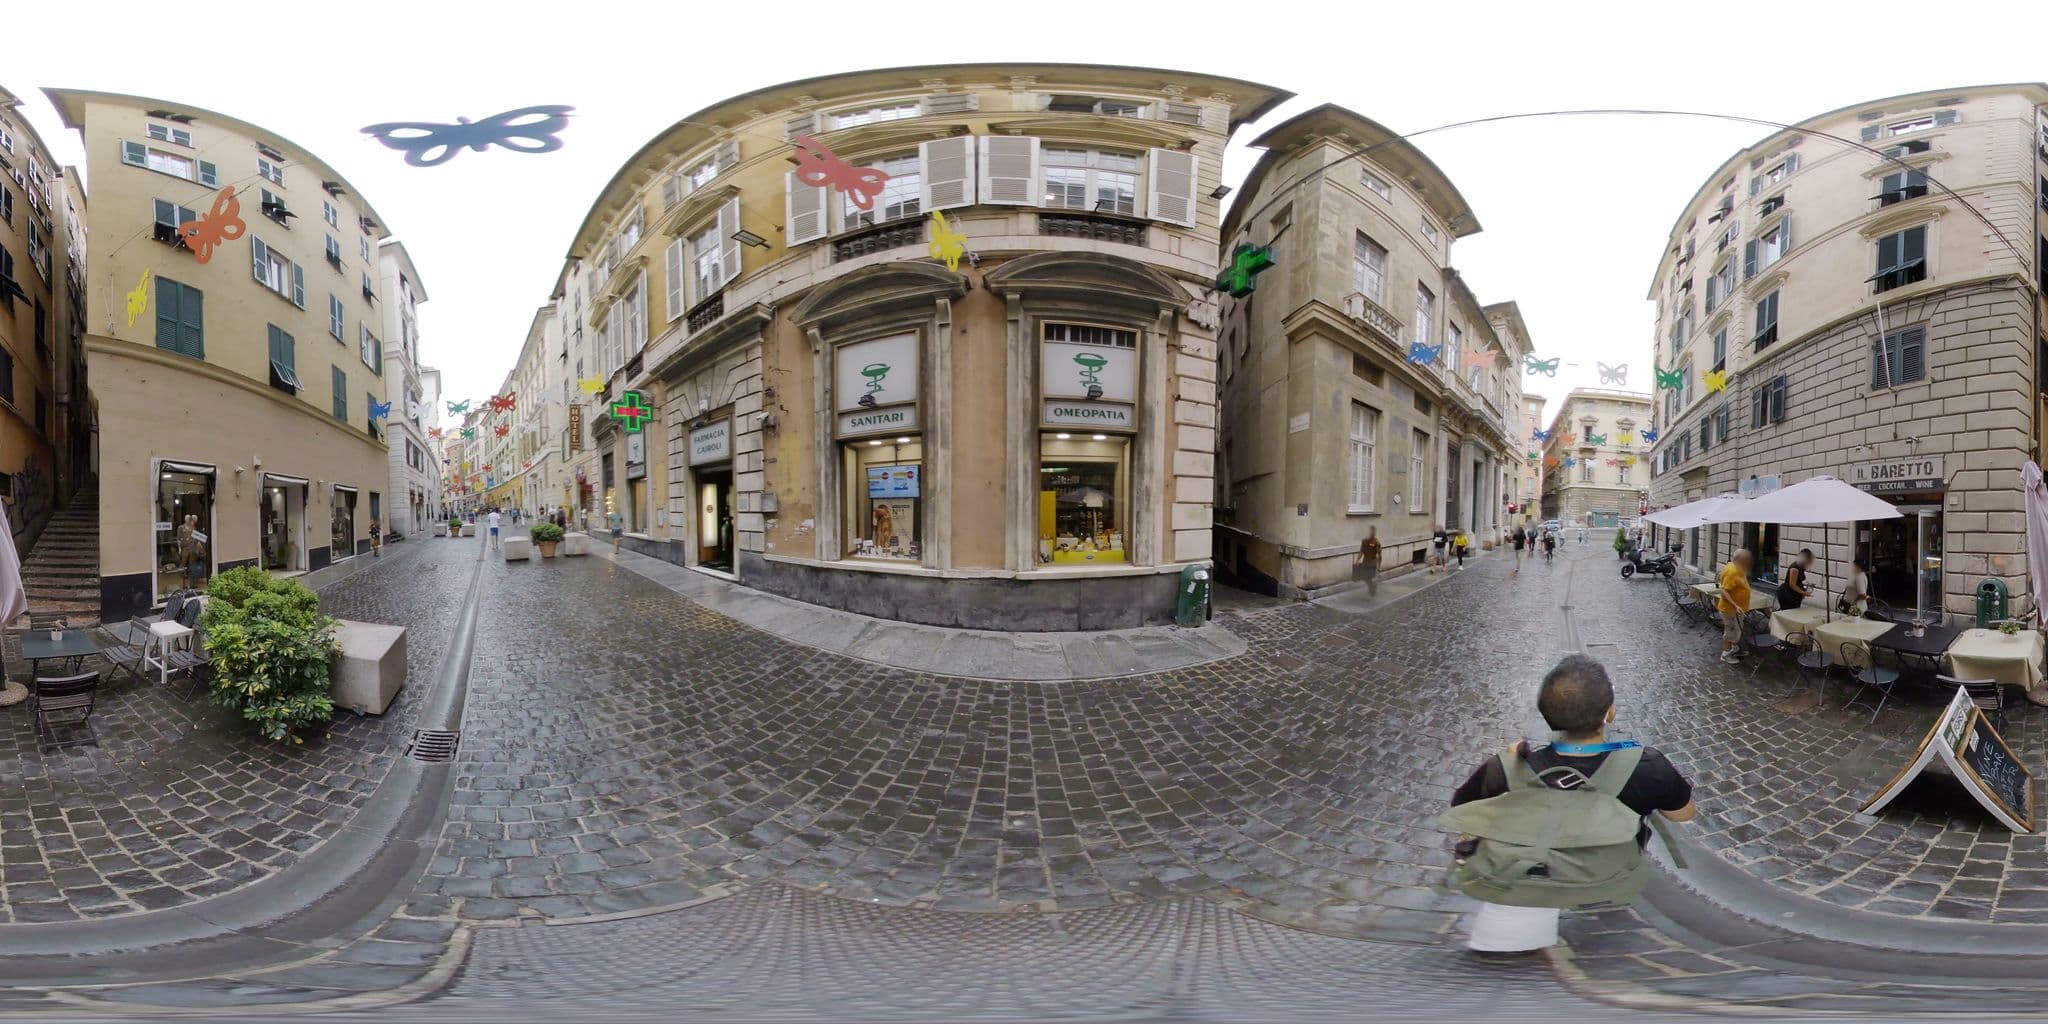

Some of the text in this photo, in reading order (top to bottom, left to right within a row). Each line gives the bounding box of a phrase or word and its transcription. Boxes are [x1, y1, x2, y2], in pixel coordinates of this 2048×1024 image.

[850, 412, 904, 428] SANITARI
[1054, 407, 1125, 420] OMEOPATIA
[571, 408, 579, 442] HOTEL
[694, 429, 725, 444] FARMACIA
[1857, 461, 1934, 480] IL BARETTO
[1879, 481, 1907, 490] COCKTAIL
[1915, 479, 1934, 489] WINE
[1977, 741, 1994, 787] WINE
[1990, 752, 2005, 781] BAR
